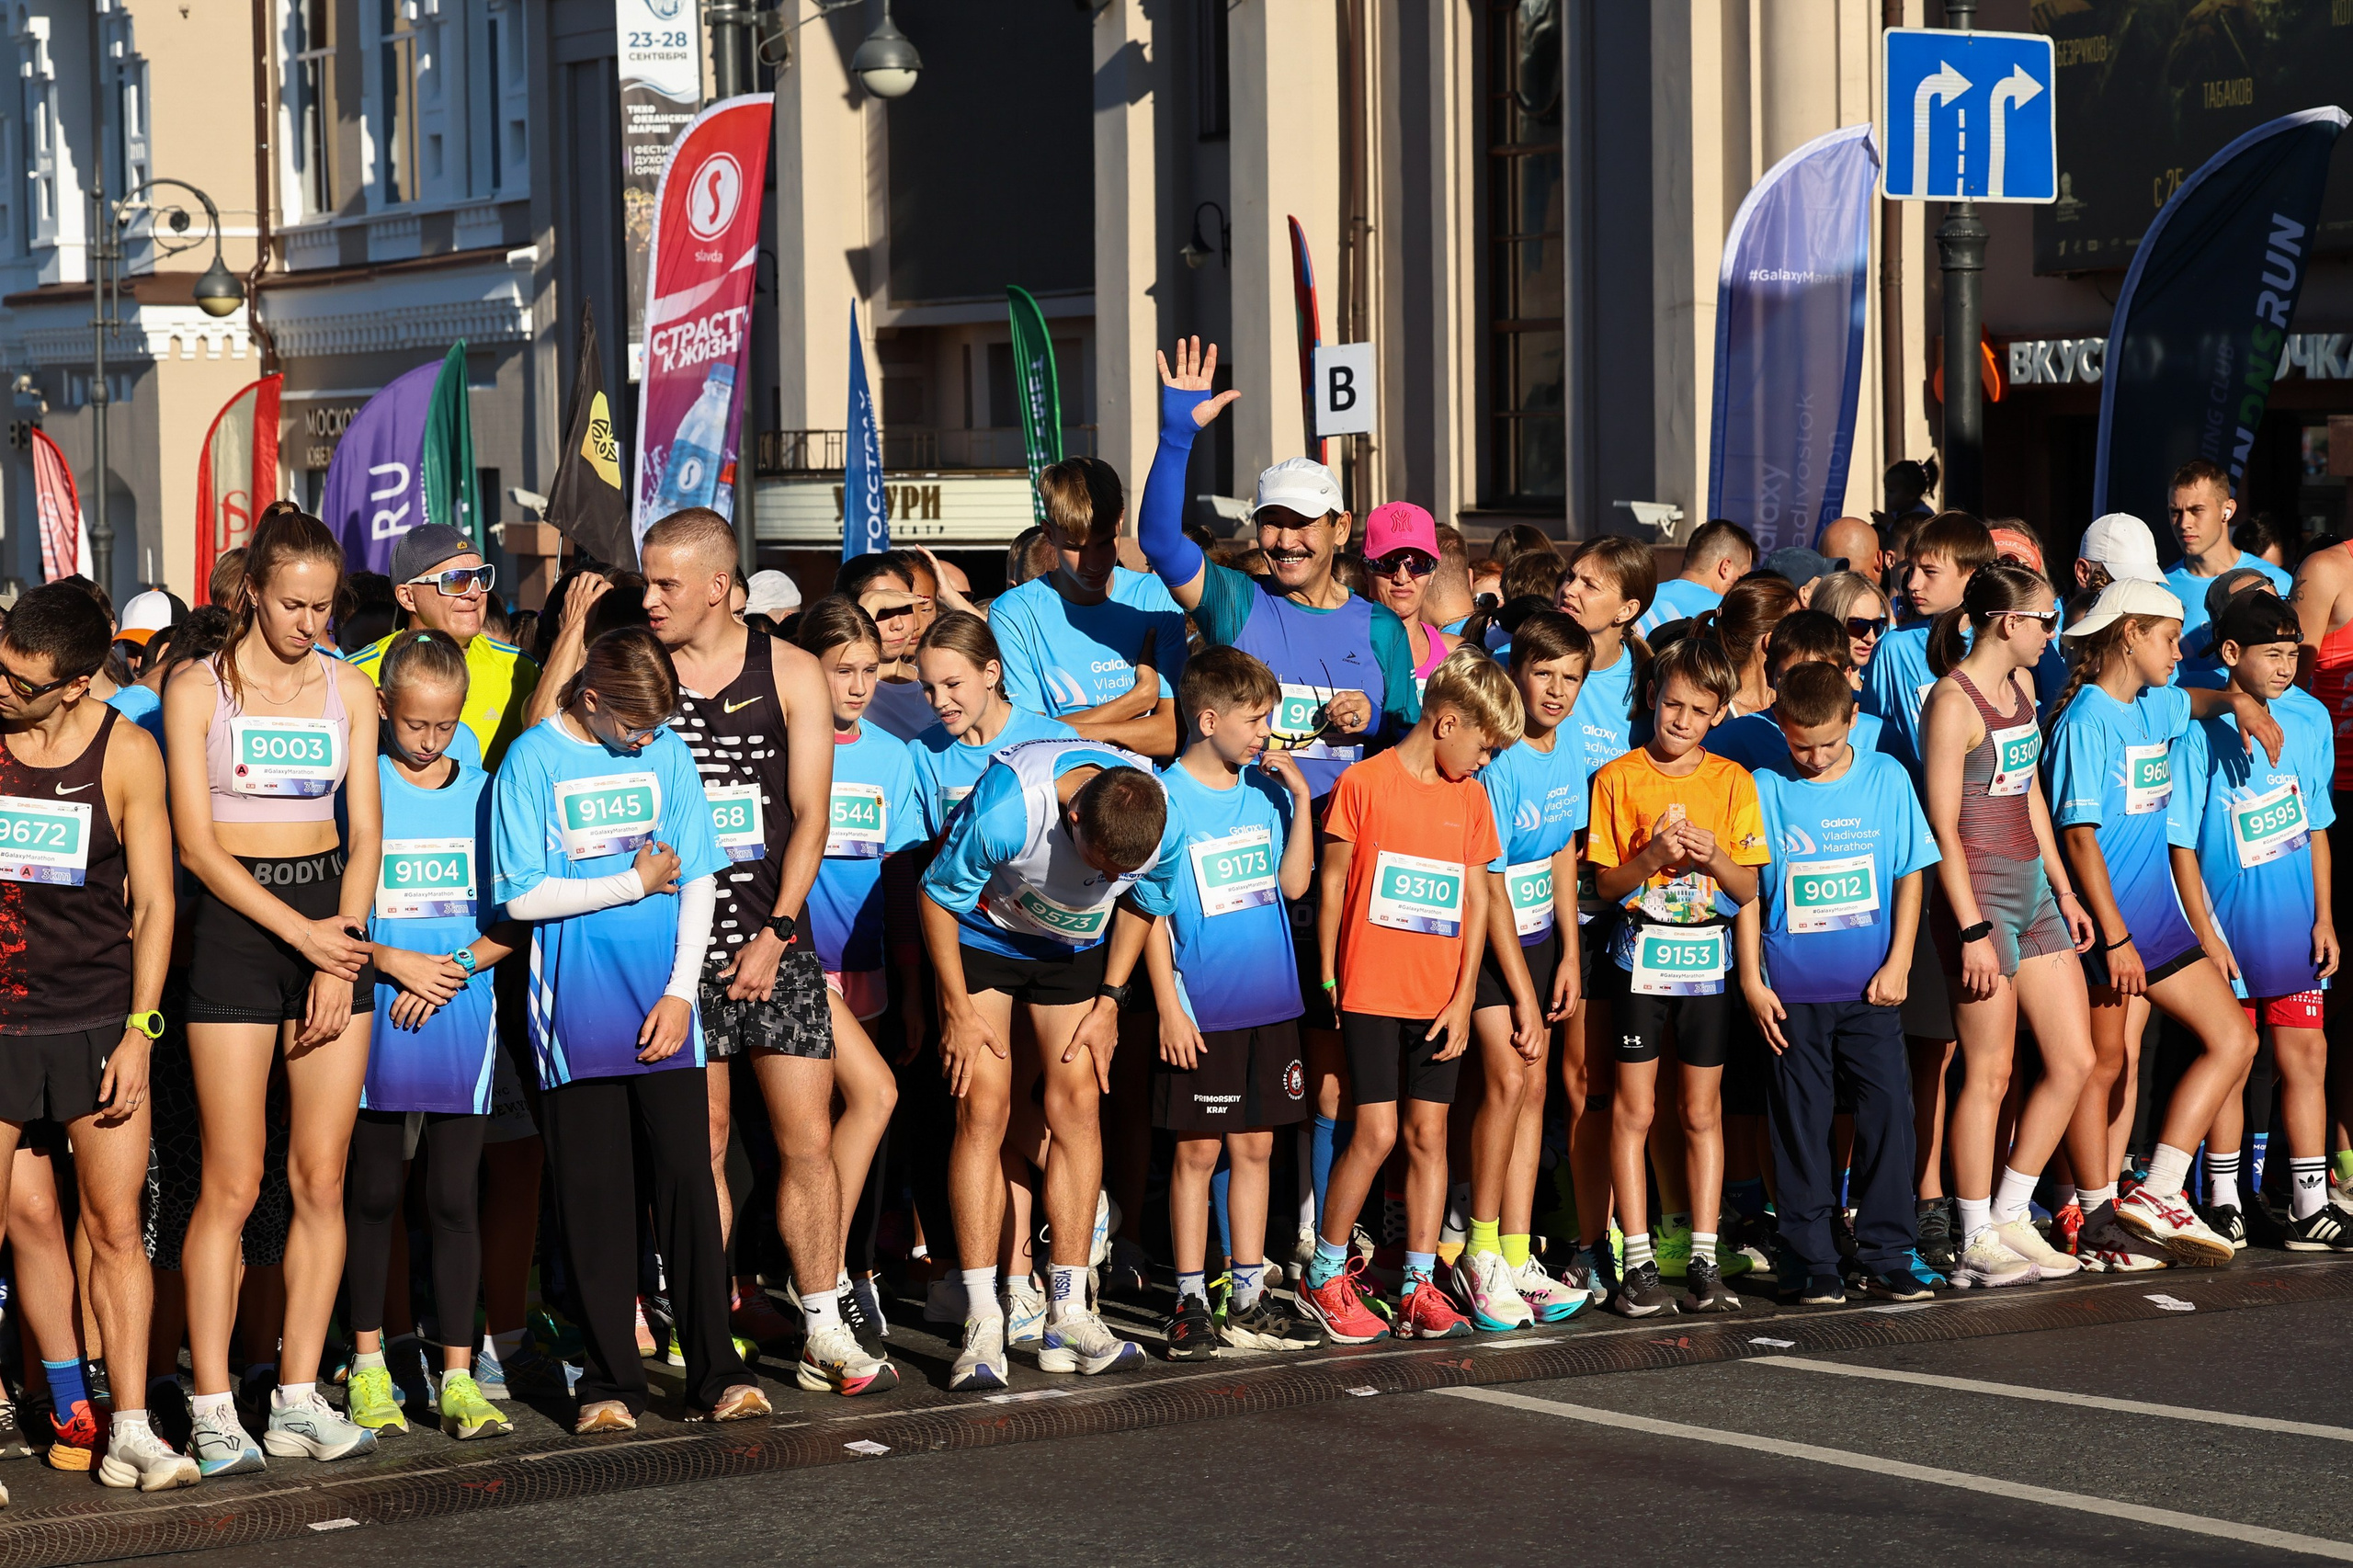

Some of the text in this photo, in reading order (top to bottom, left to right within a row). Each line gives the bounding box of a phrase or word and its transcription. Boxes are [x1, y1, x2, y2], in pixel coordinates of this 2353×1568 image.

[628, 31, 688, 47] 23-28
[629, 52, 688, 61] СЕНТЯБРЯ
[2057, 35, 2108, 67] БЕЗРУКОВ
[2203, 77, 2253, 108] ТАБАКОВ
[627, 105, 656, 114] ТИХО
[628, 124, 670, 134] МАРШИ
[634, 165, 662, 175] ОРКЕ
[695, 249, 723, 264] slavda
[1329, 365, 1357, 412] B
[305, 408, 359, 437] МОСКО
[1790, 392, 1814, 550] adivostok
[1754, 462, 1790, 556] alaxy
[1093, 675, 1135, 691] Vladiv
[251, 736, 324, 760] 9003
[2009, 736, 2039, 766] 9307
[237, 766, 246, 774] A
[579, 794, 642, 822] 9145
[876, 797, 882, 805] B
[712, 806, 745, 828] 68
[834, 801, 875, 824] 544
[1821, 817, 1861, 828] Galaxy
[2249, 801, 2296, 835] 9595
[0, 818, 66, 846] 9672
[589, 826, 639, 836] #GalaxyMarathon
[1229, 823, 1264, 835] Galaxy
[0, 851, 55, 862] #GalaxyMarathon
[726, 847, 754, 859] 3km
[21, 868, 72, 881] A 3km
[254, 858, 325, 885] BODY
[395, 859, 460, 882] 9104
[1217, 850, 1267, 880] 9173
[467, 889, 474, 897] C
[1394, 874, 1450, 902] 9310
[1520, 874, 1553, 902] 902
[1804, 876, 1862, 901] 9012
[443, 903, 469, 915] 3km
[1030, 902, 1093, 929] 9573
[1397, 904, 1442, 915] #GalaxyMarathon
[1813, 904, 1859, 915] #GalaxyMarathon
[1656, 945, 1711, 965] 9153
[1194, 1094, 1242, 1103] PRIMORSKIY
[1206, 1106, 1228, 1114] KRAY
[1053, 1268, 1073, 1301] RUSSIA
